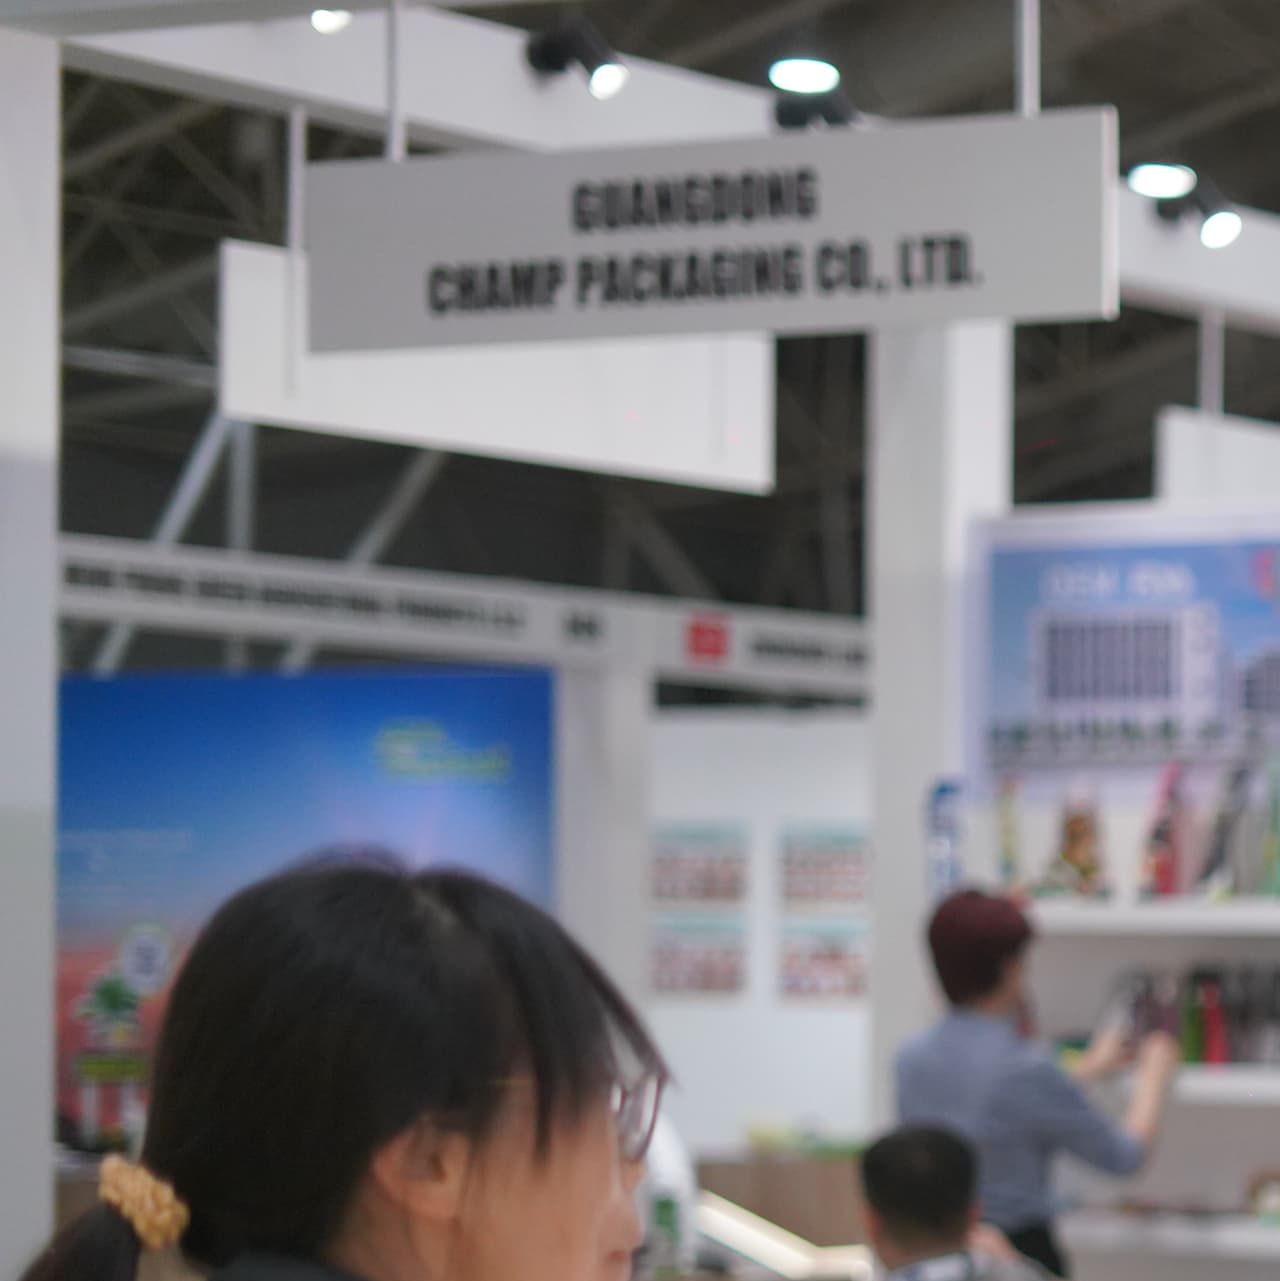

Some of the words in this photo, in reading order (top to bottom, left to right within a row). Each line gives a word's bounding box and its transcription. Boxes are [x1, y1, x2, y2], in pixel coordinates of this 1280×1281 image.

[573, 168, 816, 232] GUANGDONG
[428, 260, 562, 315] CHAMP
[577, 243, 802, 303] PACKAGING
[900, 233, 982, 288] LTD.
